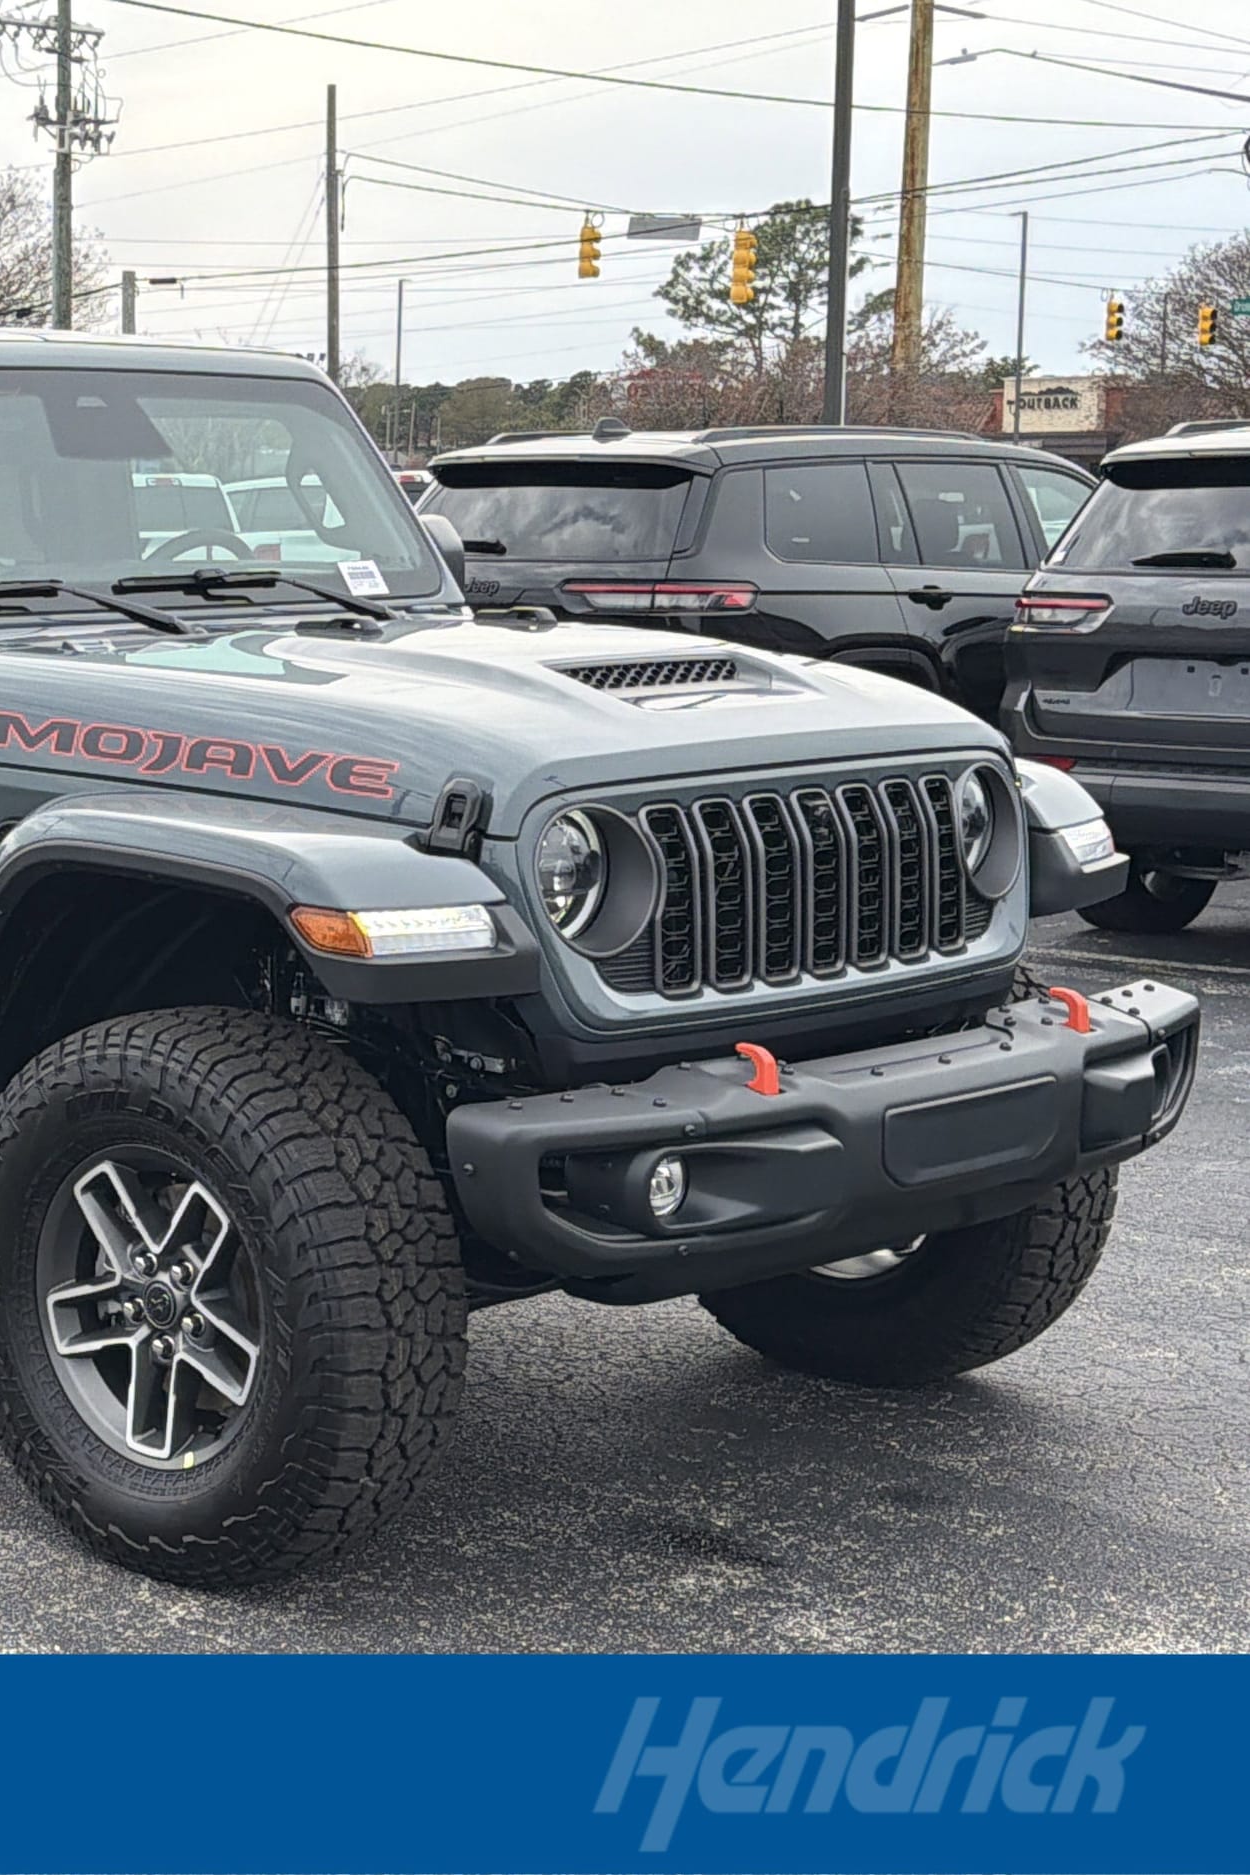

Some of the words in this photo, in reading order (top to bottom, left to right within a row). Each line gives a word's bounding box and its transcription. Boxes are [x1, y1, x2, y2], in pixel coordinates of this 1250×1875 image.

[1019, 397, 1079, 410] OUTBACK
[464, 577, 500, 597] Jeep
[1182, 596, 1238, 620] Jeep
